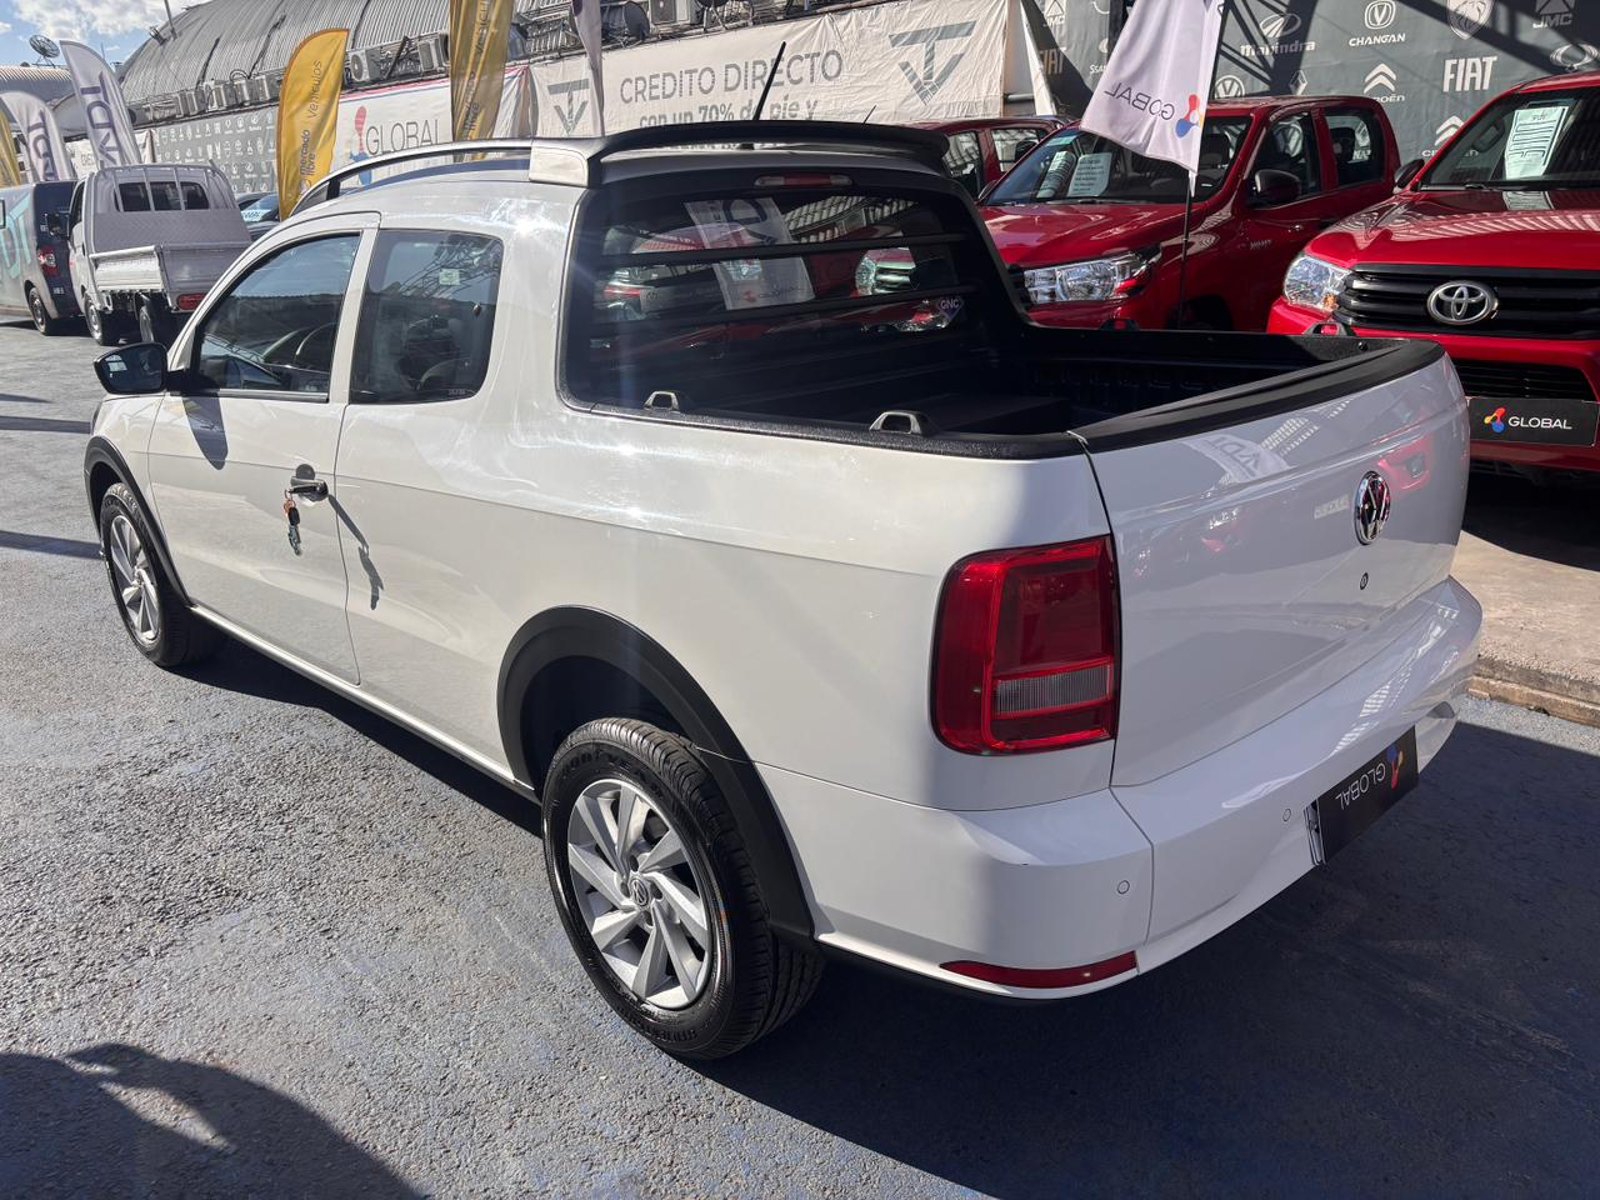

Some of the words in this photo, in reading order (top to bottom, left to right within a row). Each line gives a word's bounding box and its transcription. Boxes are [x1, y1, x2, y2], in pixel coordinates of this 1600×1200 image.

[1532, 13, 1573, 29] JMC
[1349, 33, 1406, 47] CHANGAN
[620, 66, 716, 104] CREDITO
[724, 50, 843, 92] DIRECTO
[1443, 56, 1498, 92] FIAT
[673, 111, 693, 124] un
[698, 102, 735, 121] 70%
[740, 99, 757, 120] d
[769, 94, 800, 120] pie
[1508, 416, 1573, 430] GLOBAL
[1335, 762, 1386, 810] GLOBAL
